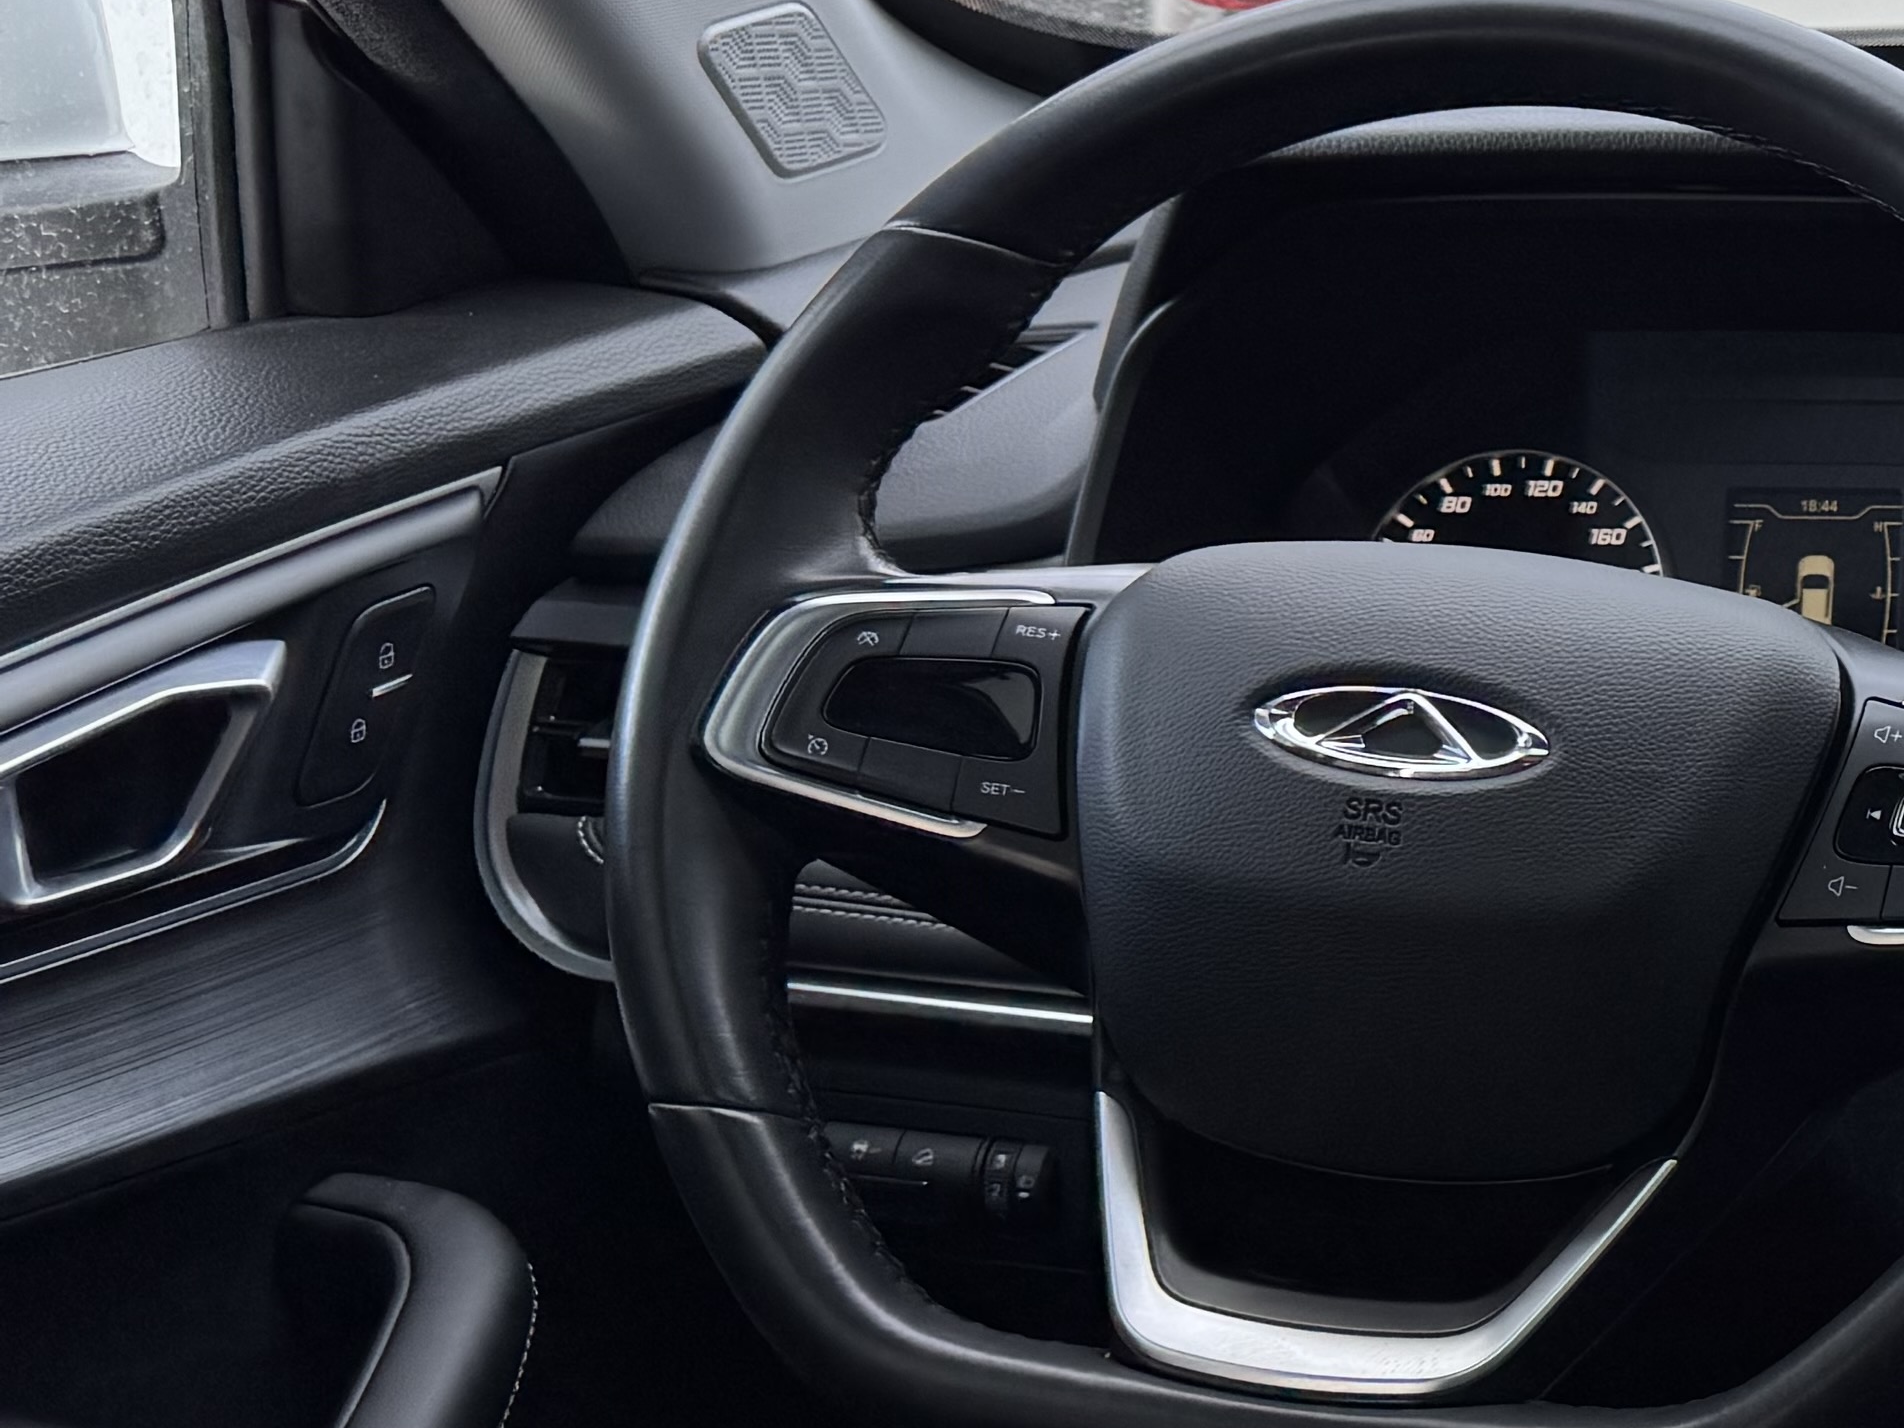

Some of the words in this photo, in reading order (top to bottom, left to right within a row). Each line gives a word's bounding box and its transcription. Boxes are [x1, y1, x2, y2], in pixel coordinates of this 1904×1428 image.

[1483, 483, 1513, 497] 100
[1526, 479, 1564, 498] 120
[1439, 496, 1472, 514] 80
[1571, 501, 1598, 514] 140
[1801, 499, 1838, 513] 18:44
[1589, 528, 1626, 546] 160
[1343, 797, 1403, 826] SRS
[1336, 824, 1402, 846] AIRBAG
